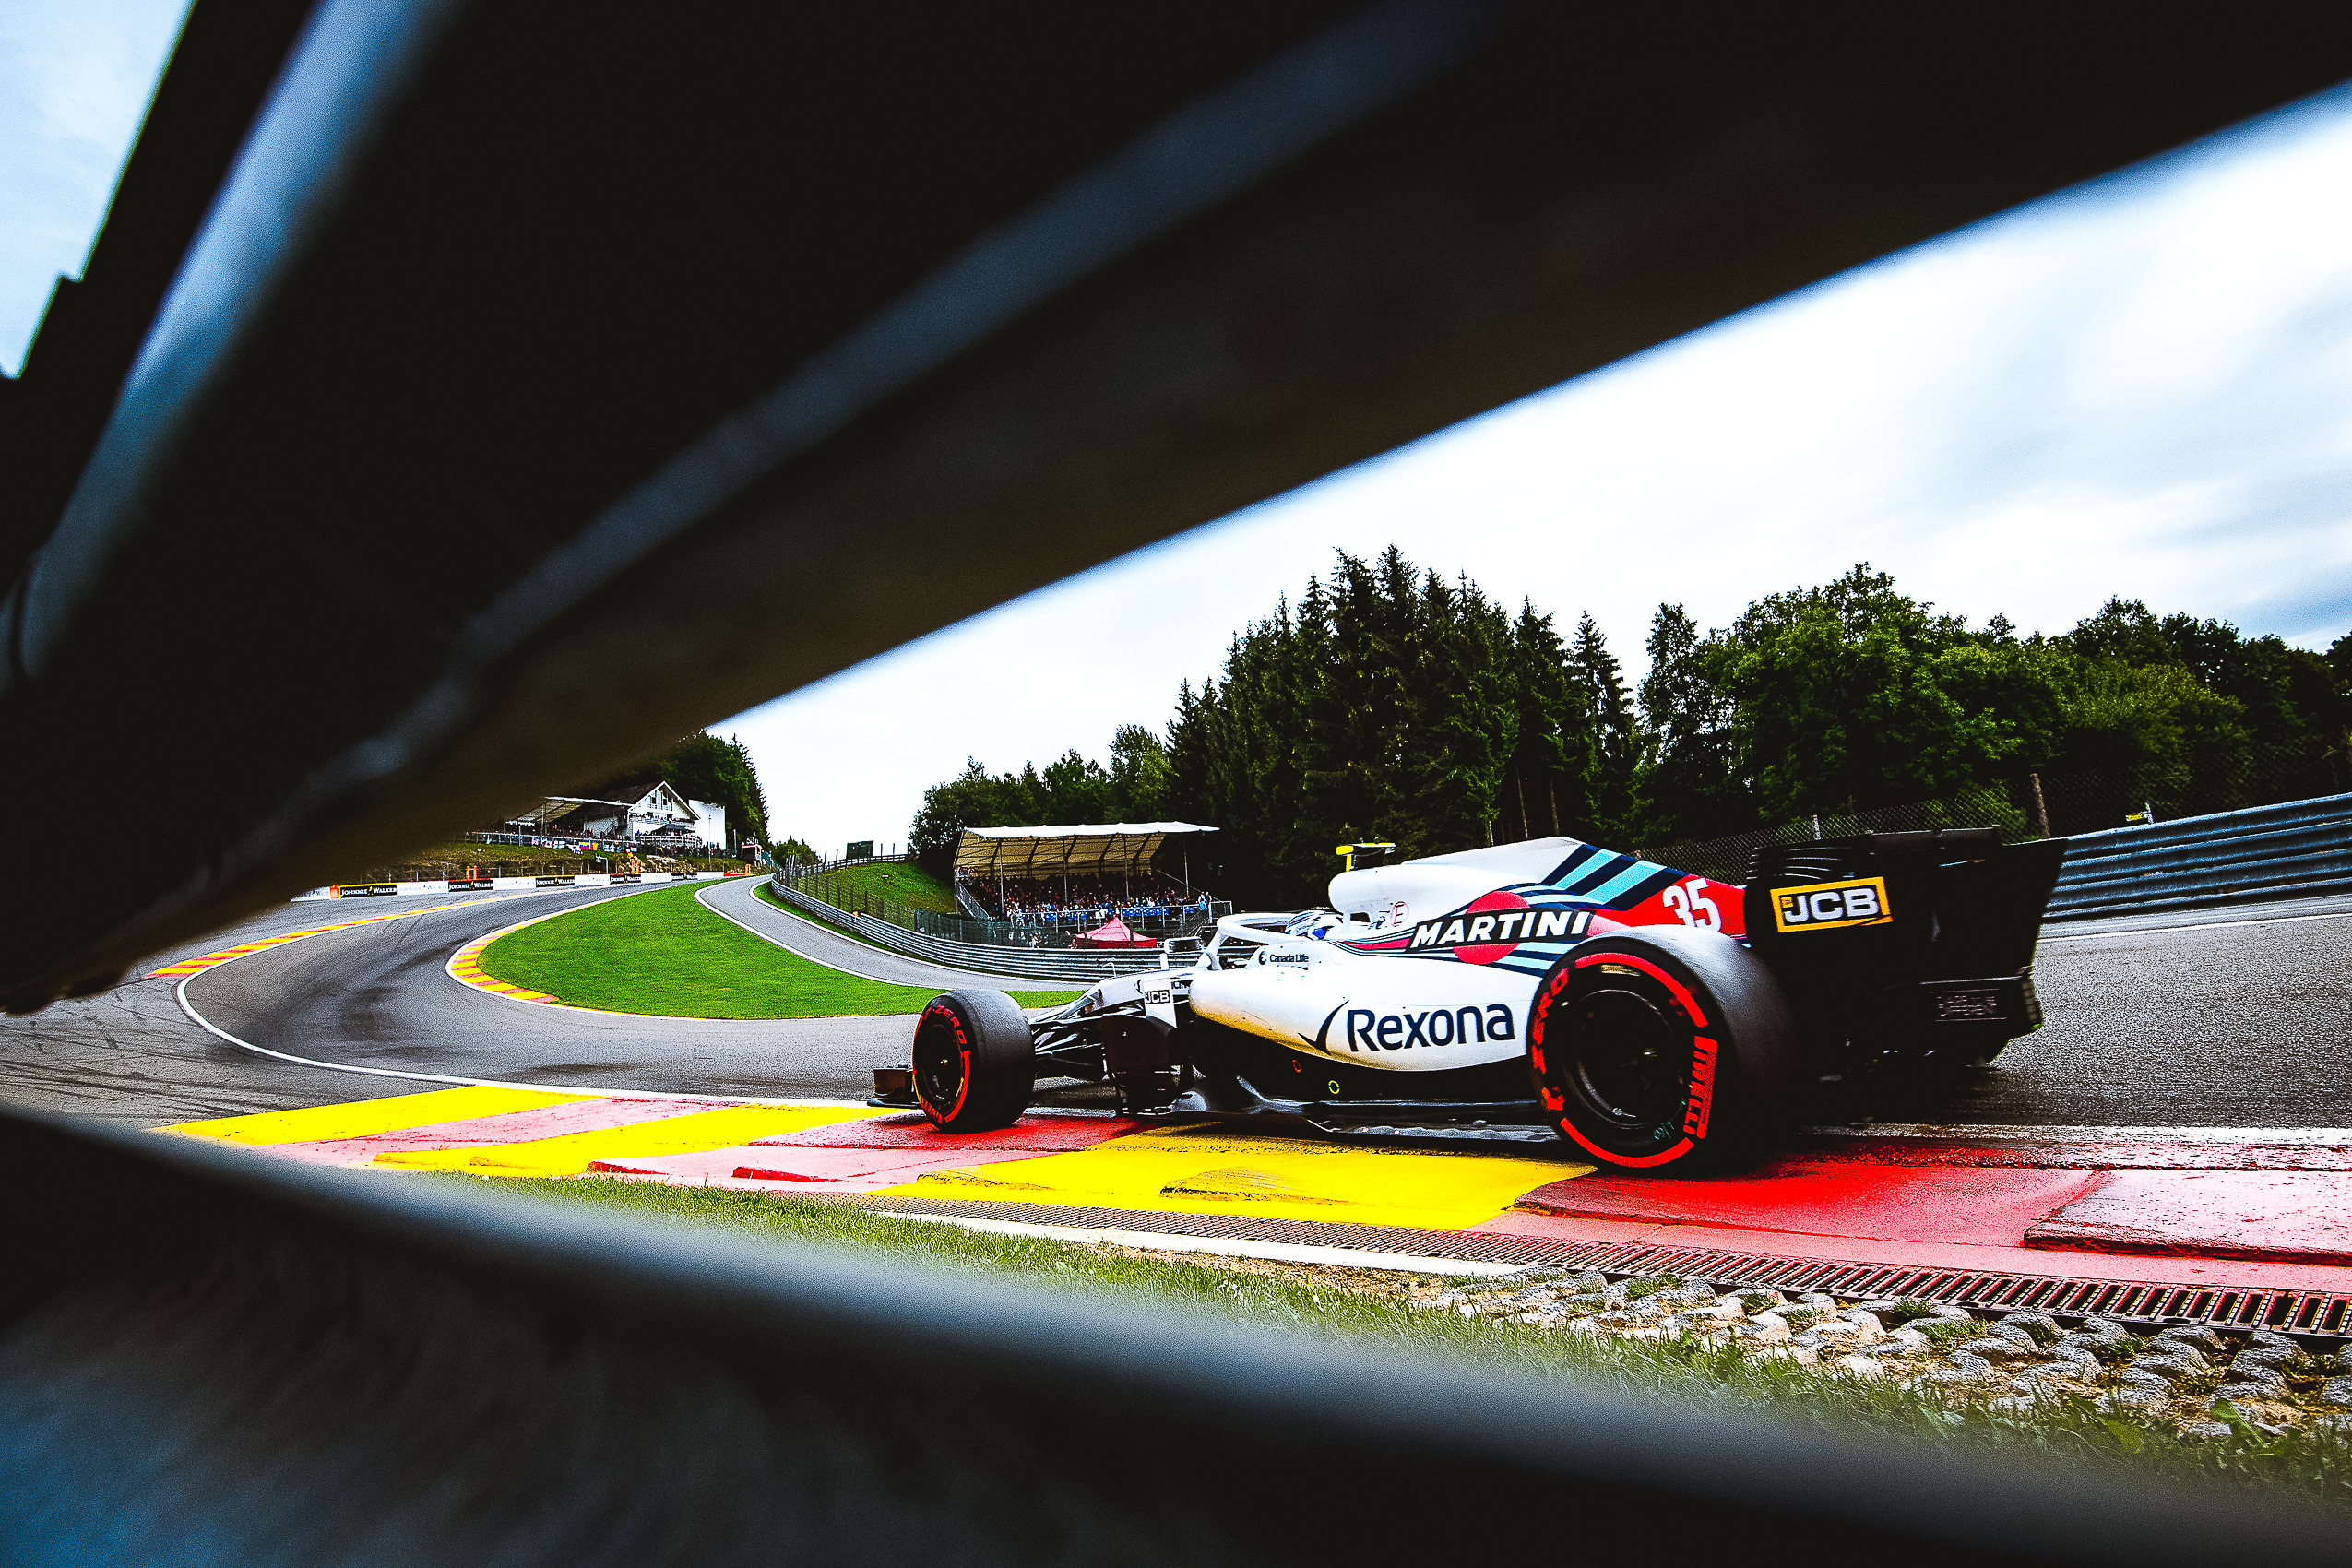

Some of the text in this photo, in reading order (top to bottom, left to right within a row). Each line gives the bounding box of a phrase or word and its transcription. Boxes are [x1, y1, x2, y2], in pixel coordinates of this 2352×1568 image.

[1662, 878, 1722, 932] 35
[1783, 887, 1880, 923] JCB
[1410, 910, 1590, 949] MARTINI
[1269, 953, 1309, 962] Canada Life
[1145, 991, 1170, 1004] JCB
[934, 1004, 967, 1045] ZERO
[1347, 1003, 1515, 1052] Rexona
